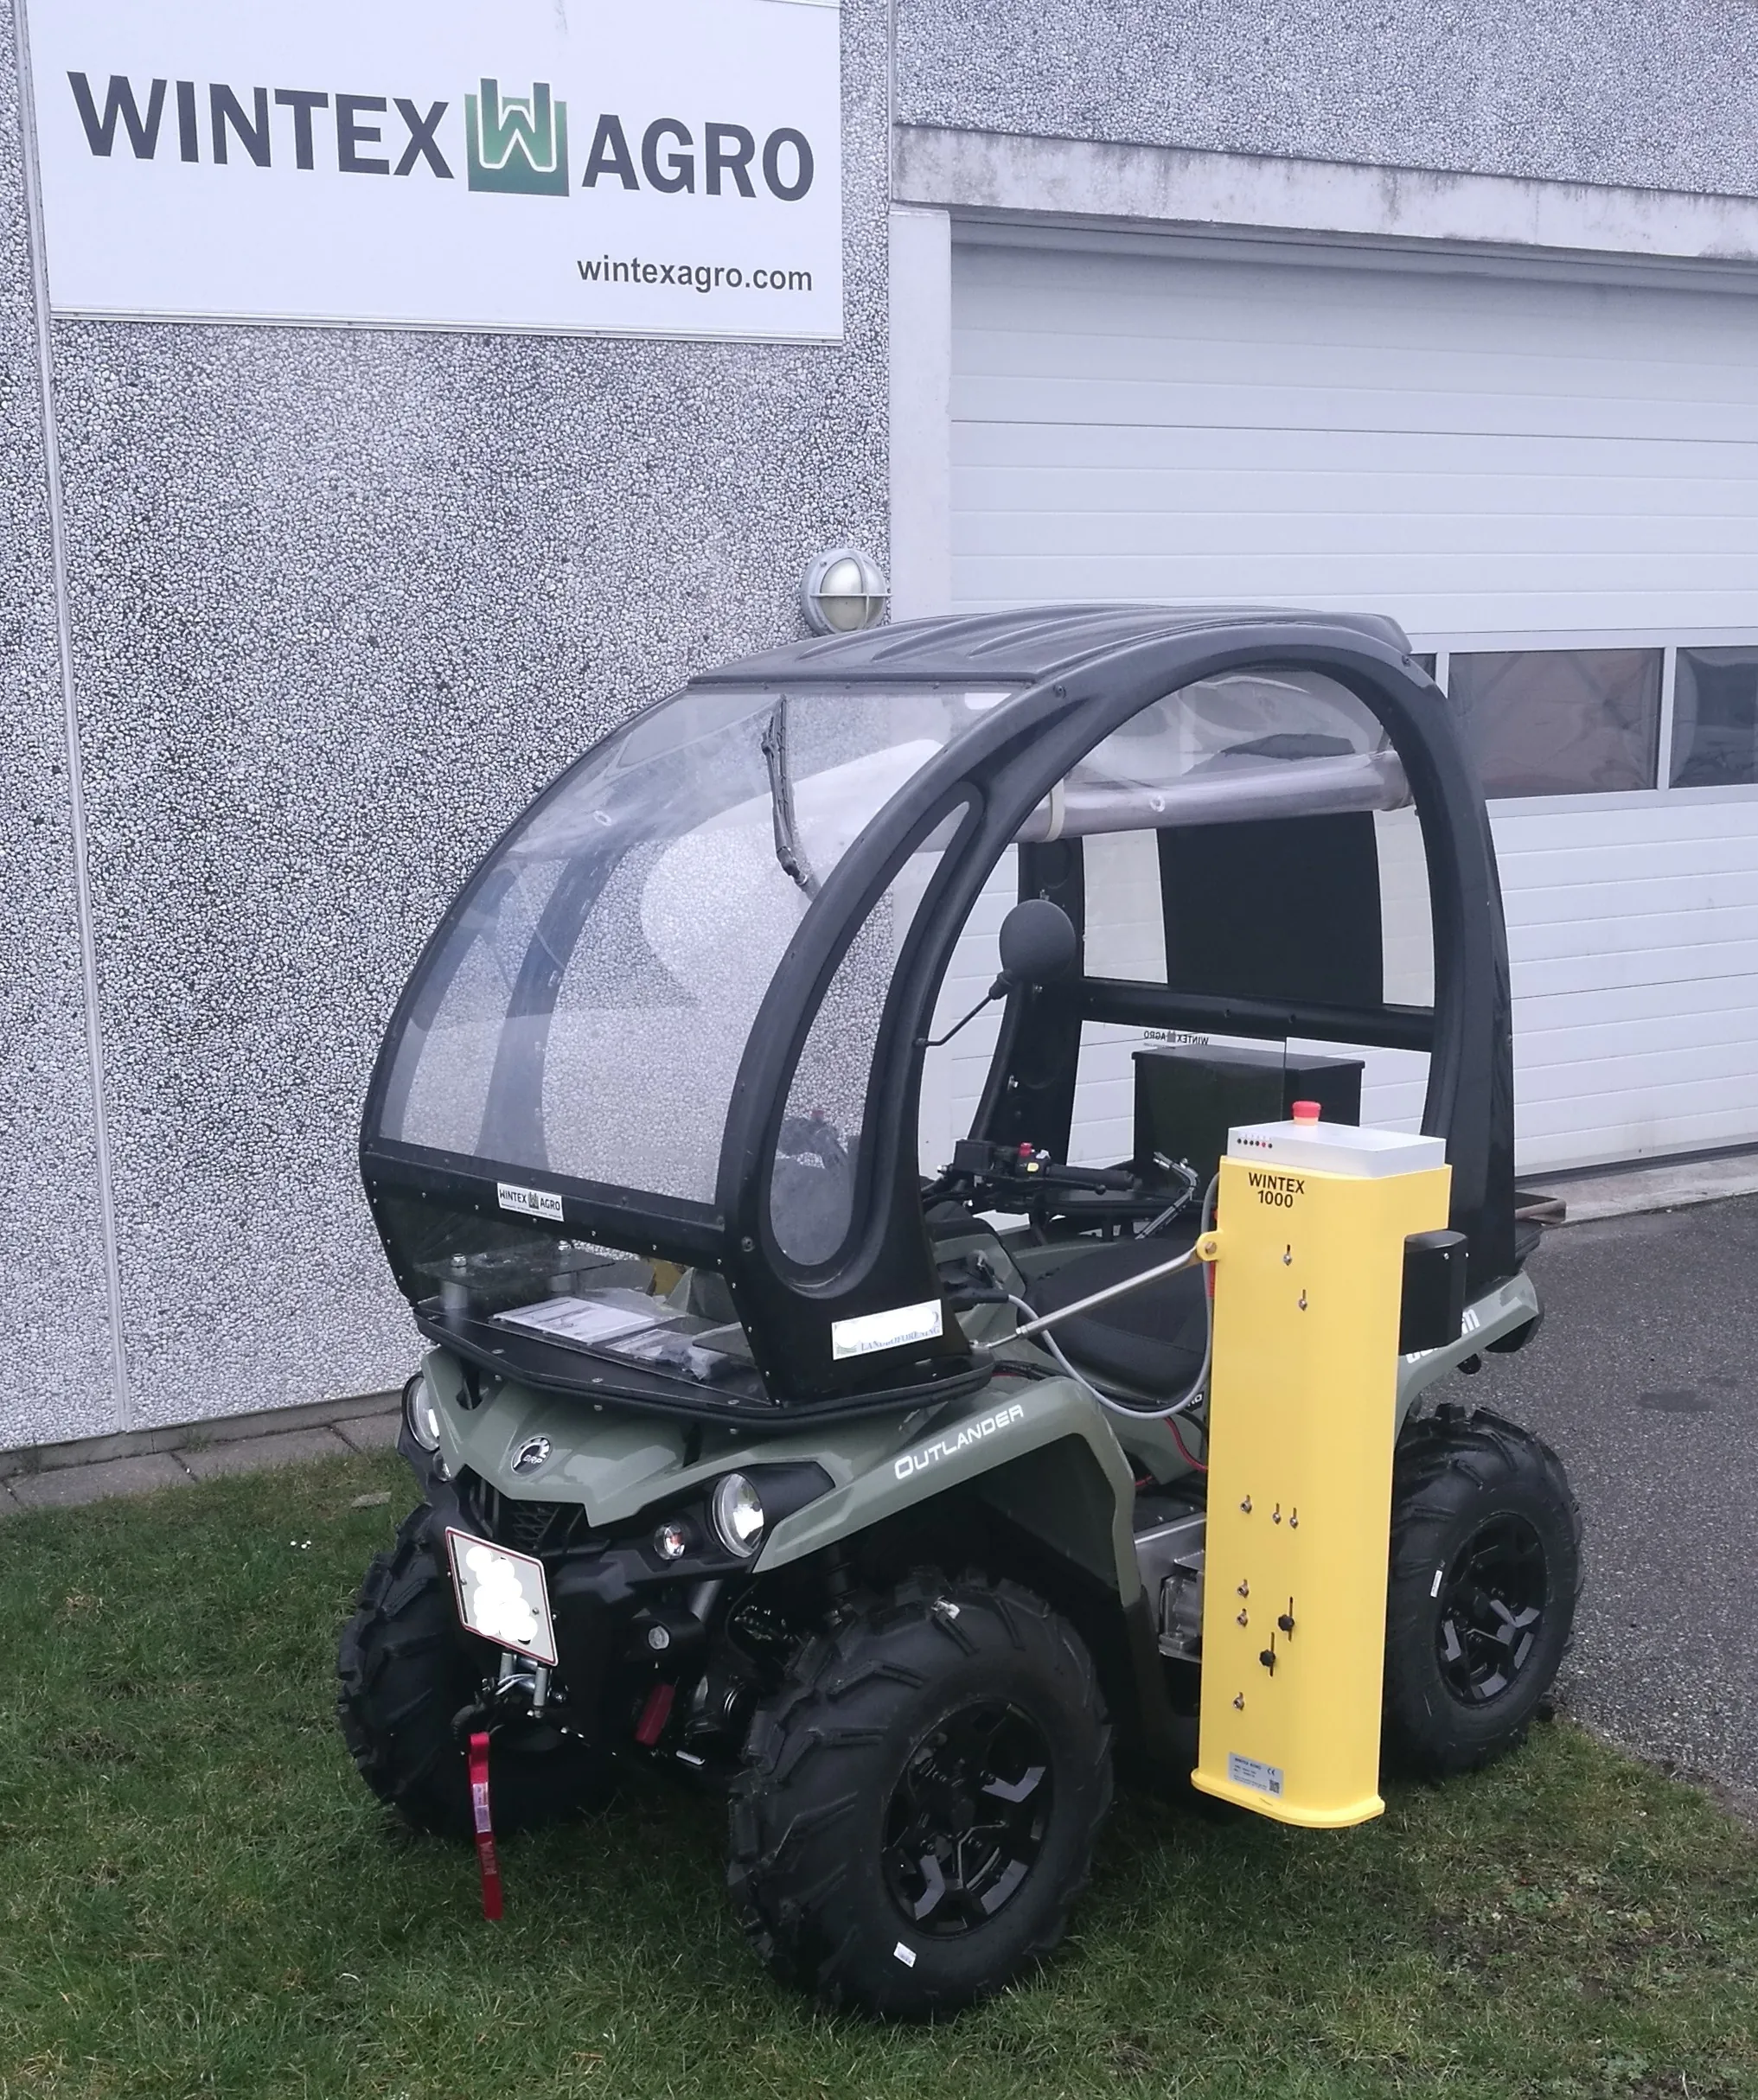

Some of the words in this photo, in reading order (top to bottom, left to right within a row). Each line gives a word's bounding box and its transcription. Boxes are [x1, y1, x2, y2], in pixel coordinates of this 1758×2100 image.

[67, 71, 455, 179] WINTEX
[581, 113, 815, 201] AGRO
[577, 255, 813, 293] wintexagro.com
[1248, 1171, 1305, 1195] WINTEX
[499, 1189, 527, 1204] WINTEX
[540, 1197, 561, 1211] AGRO
[1257, 1190, 1294, 1209] 1000
[894, 1404, 1024, 1480] OUTLANDER
[523, 1454, 543, 1465] BRP
